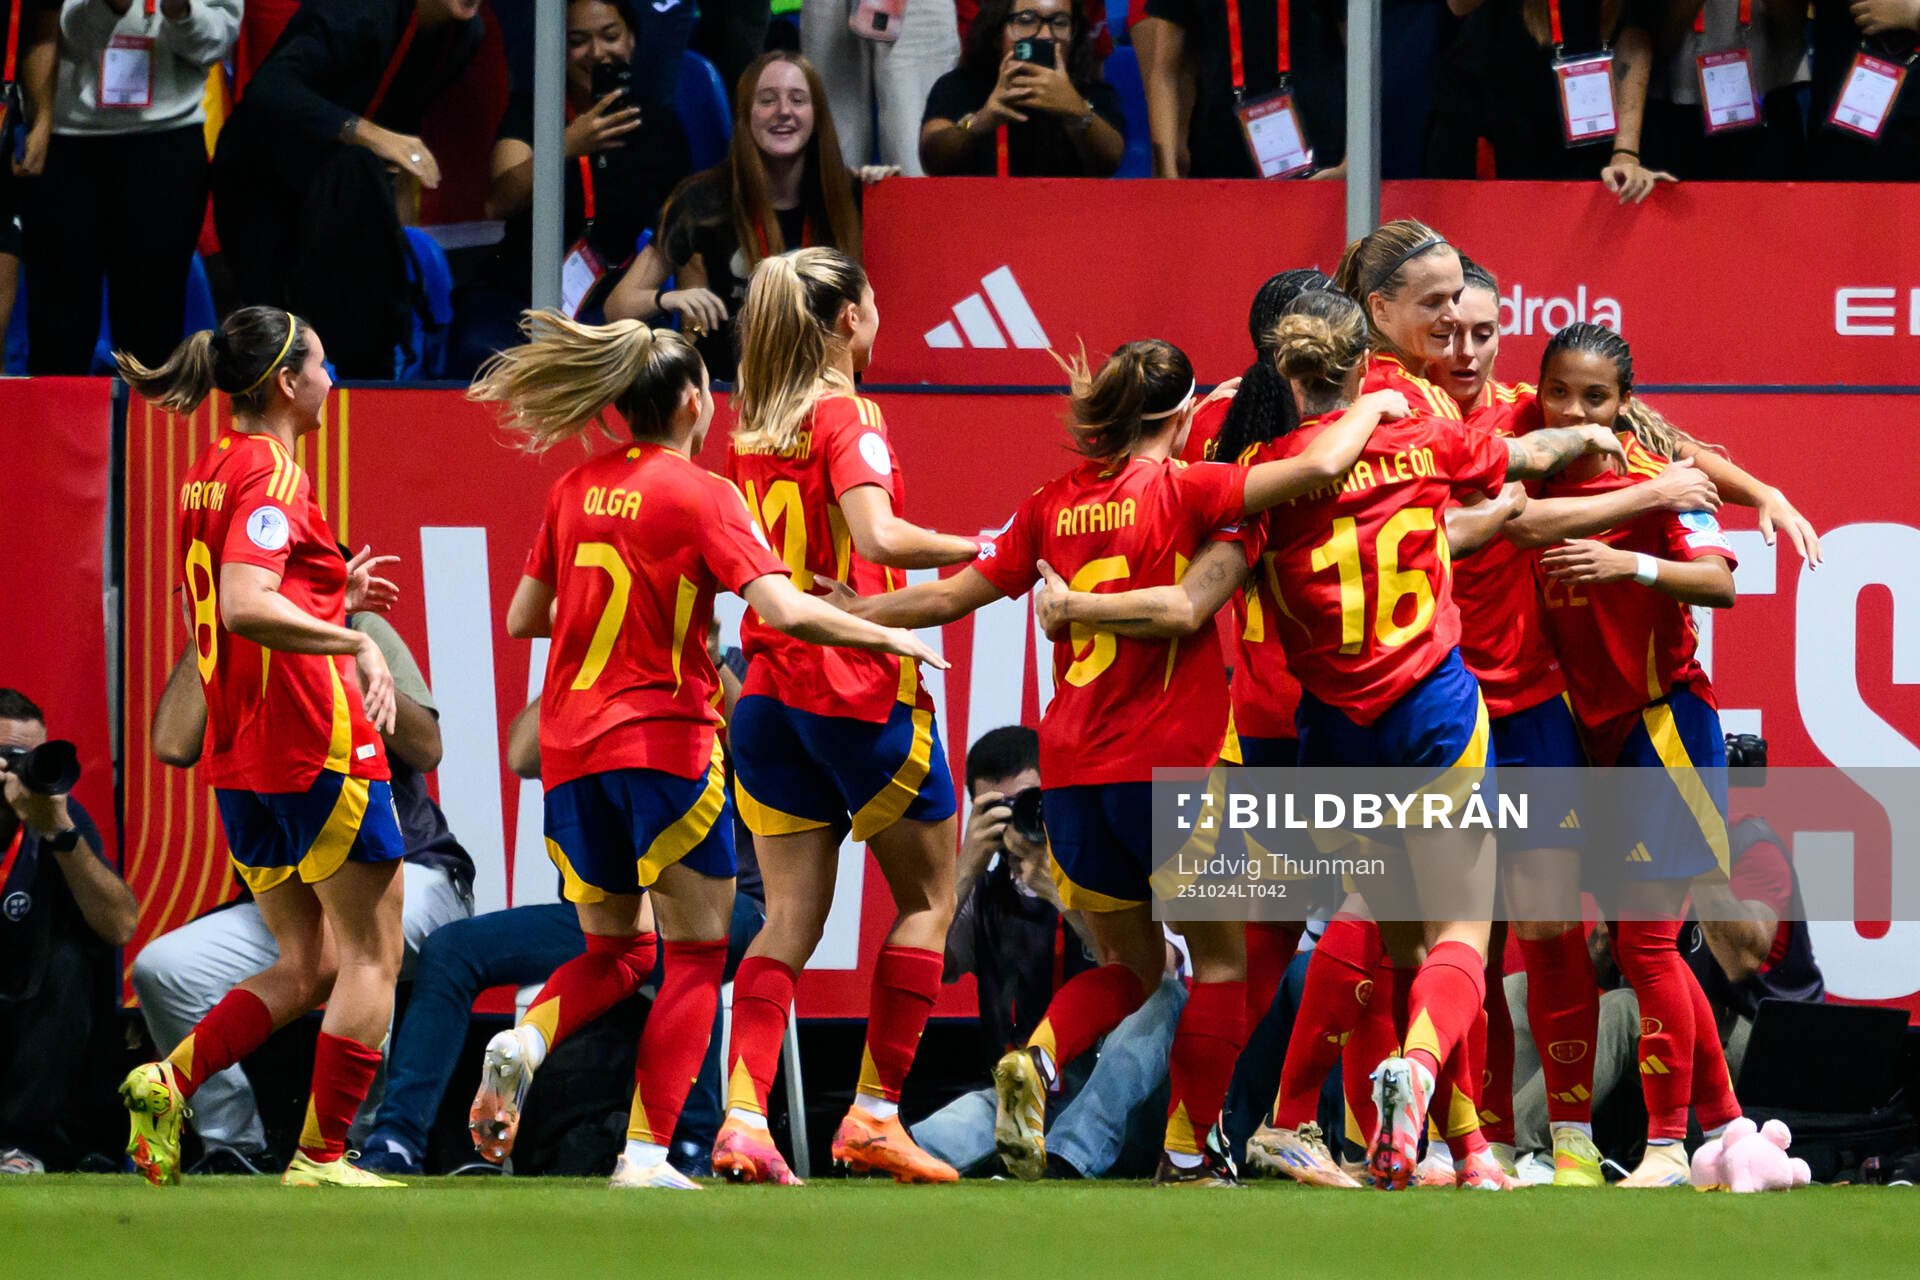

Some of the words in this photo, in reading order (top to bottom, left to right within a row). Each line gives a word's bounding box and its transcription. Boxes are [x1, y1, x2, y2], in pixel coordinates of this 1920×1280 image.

[1835, 288, 1920, 336] E
[583, 485, 642, 521] OLGA
[1056, 497, 1136, 537] AITANA
[185, 538, 218, 685] 8
[570, 542, 632, 690] 7
[1311, 507, 1437, 654] 16
